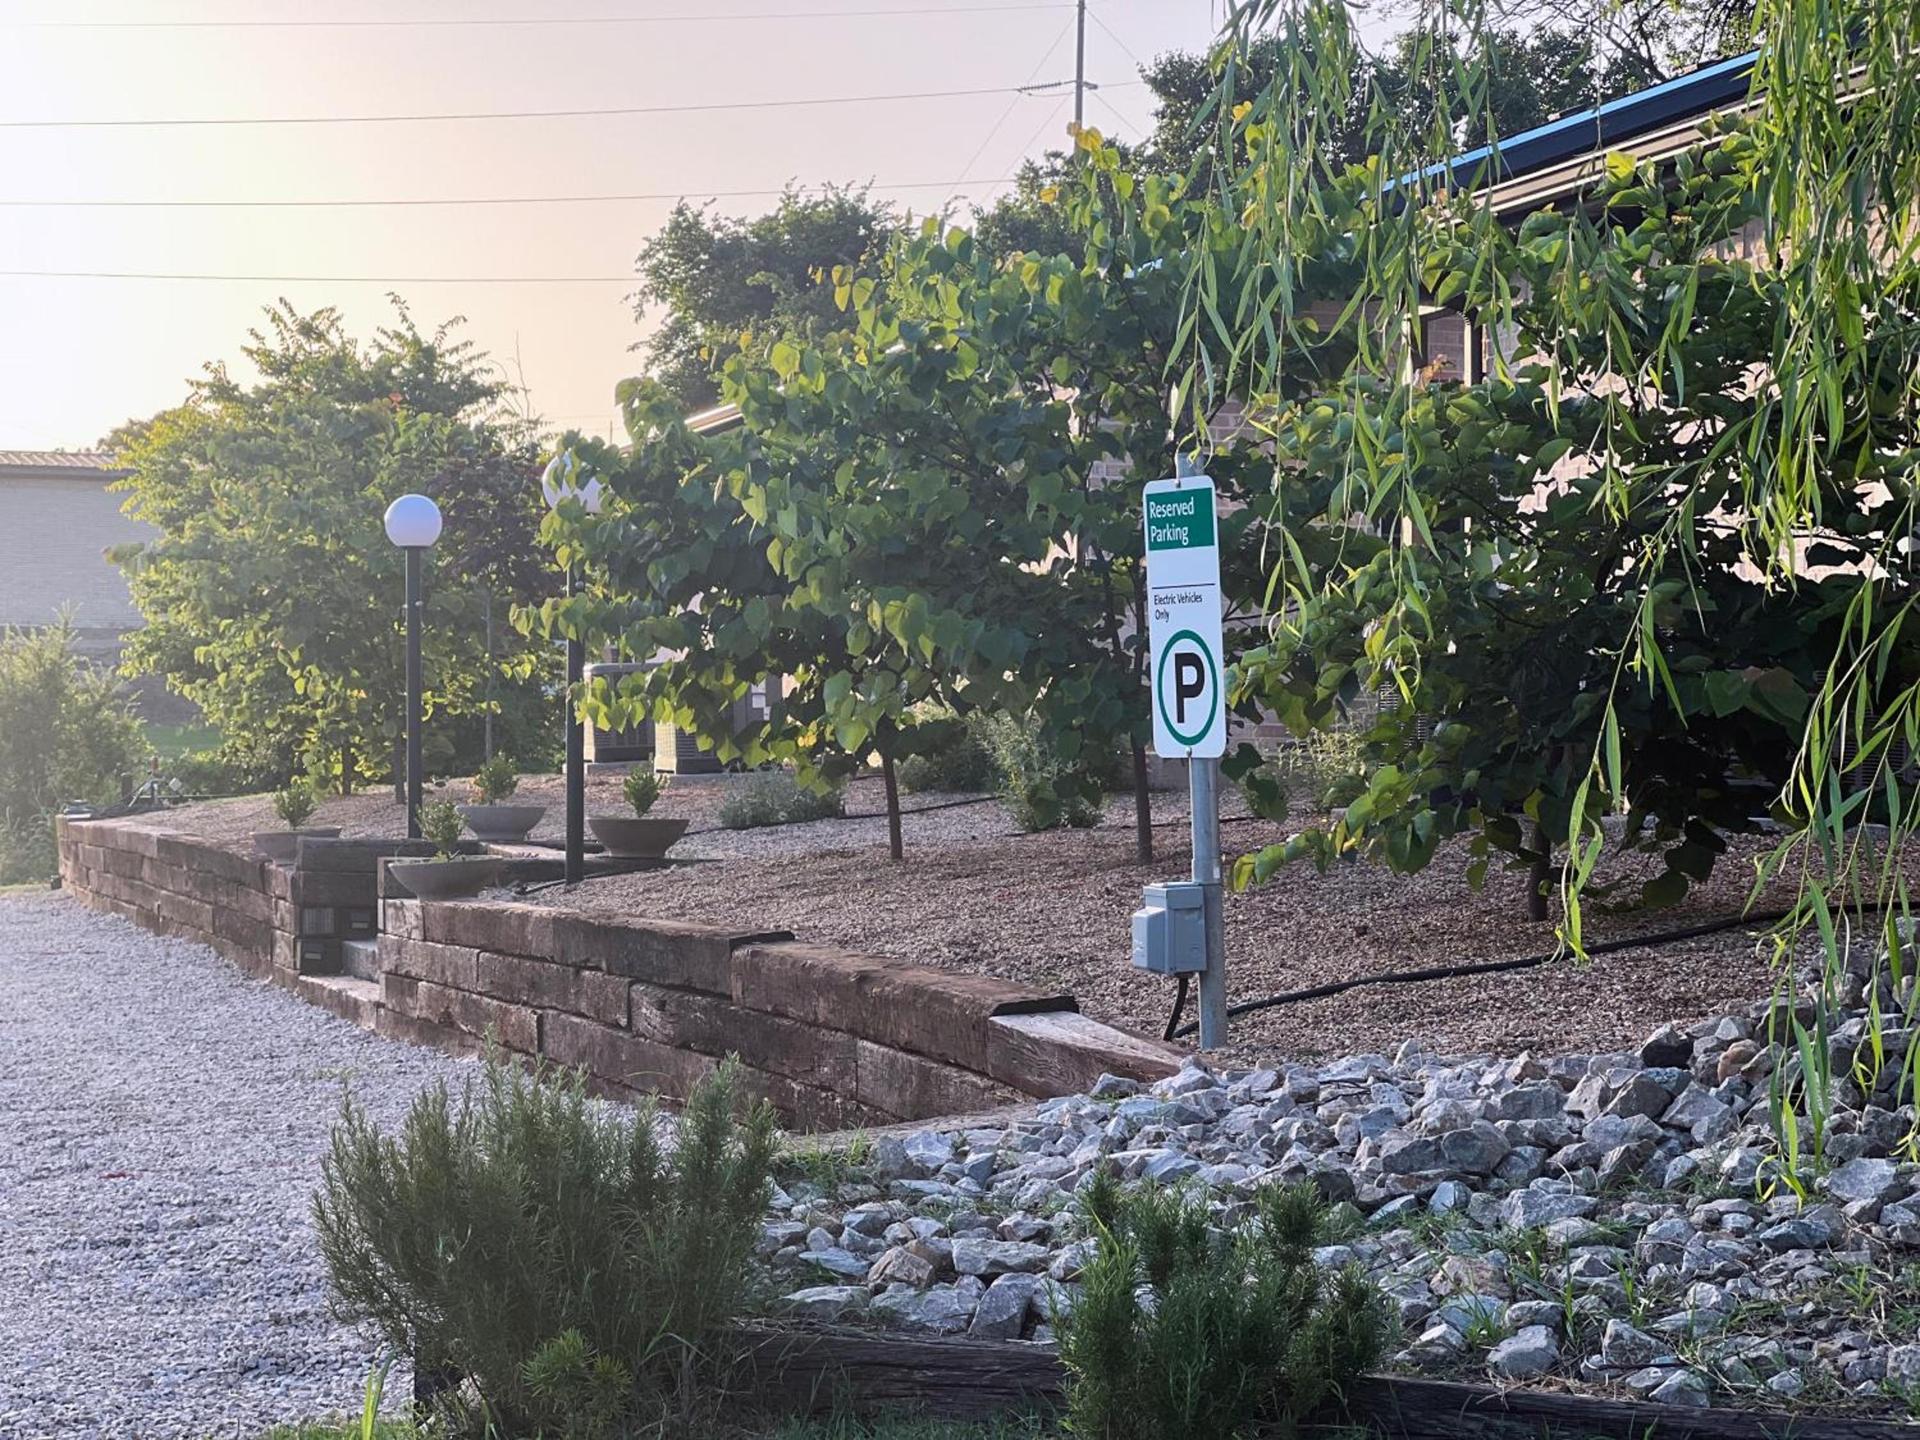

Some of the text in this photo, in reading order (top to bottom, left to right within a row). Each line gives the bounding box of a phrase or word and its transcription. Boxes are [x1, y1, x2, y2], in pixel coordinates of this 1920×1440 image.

[1149, 496, 1194, 519] Reserved
[1150, 523, 1189, 546] Parking
[1154, 592, 1203, 605] Electric Vehicles
[1155, 608, 1169, 623] Only
[1174, 652, 1205, 724] P
